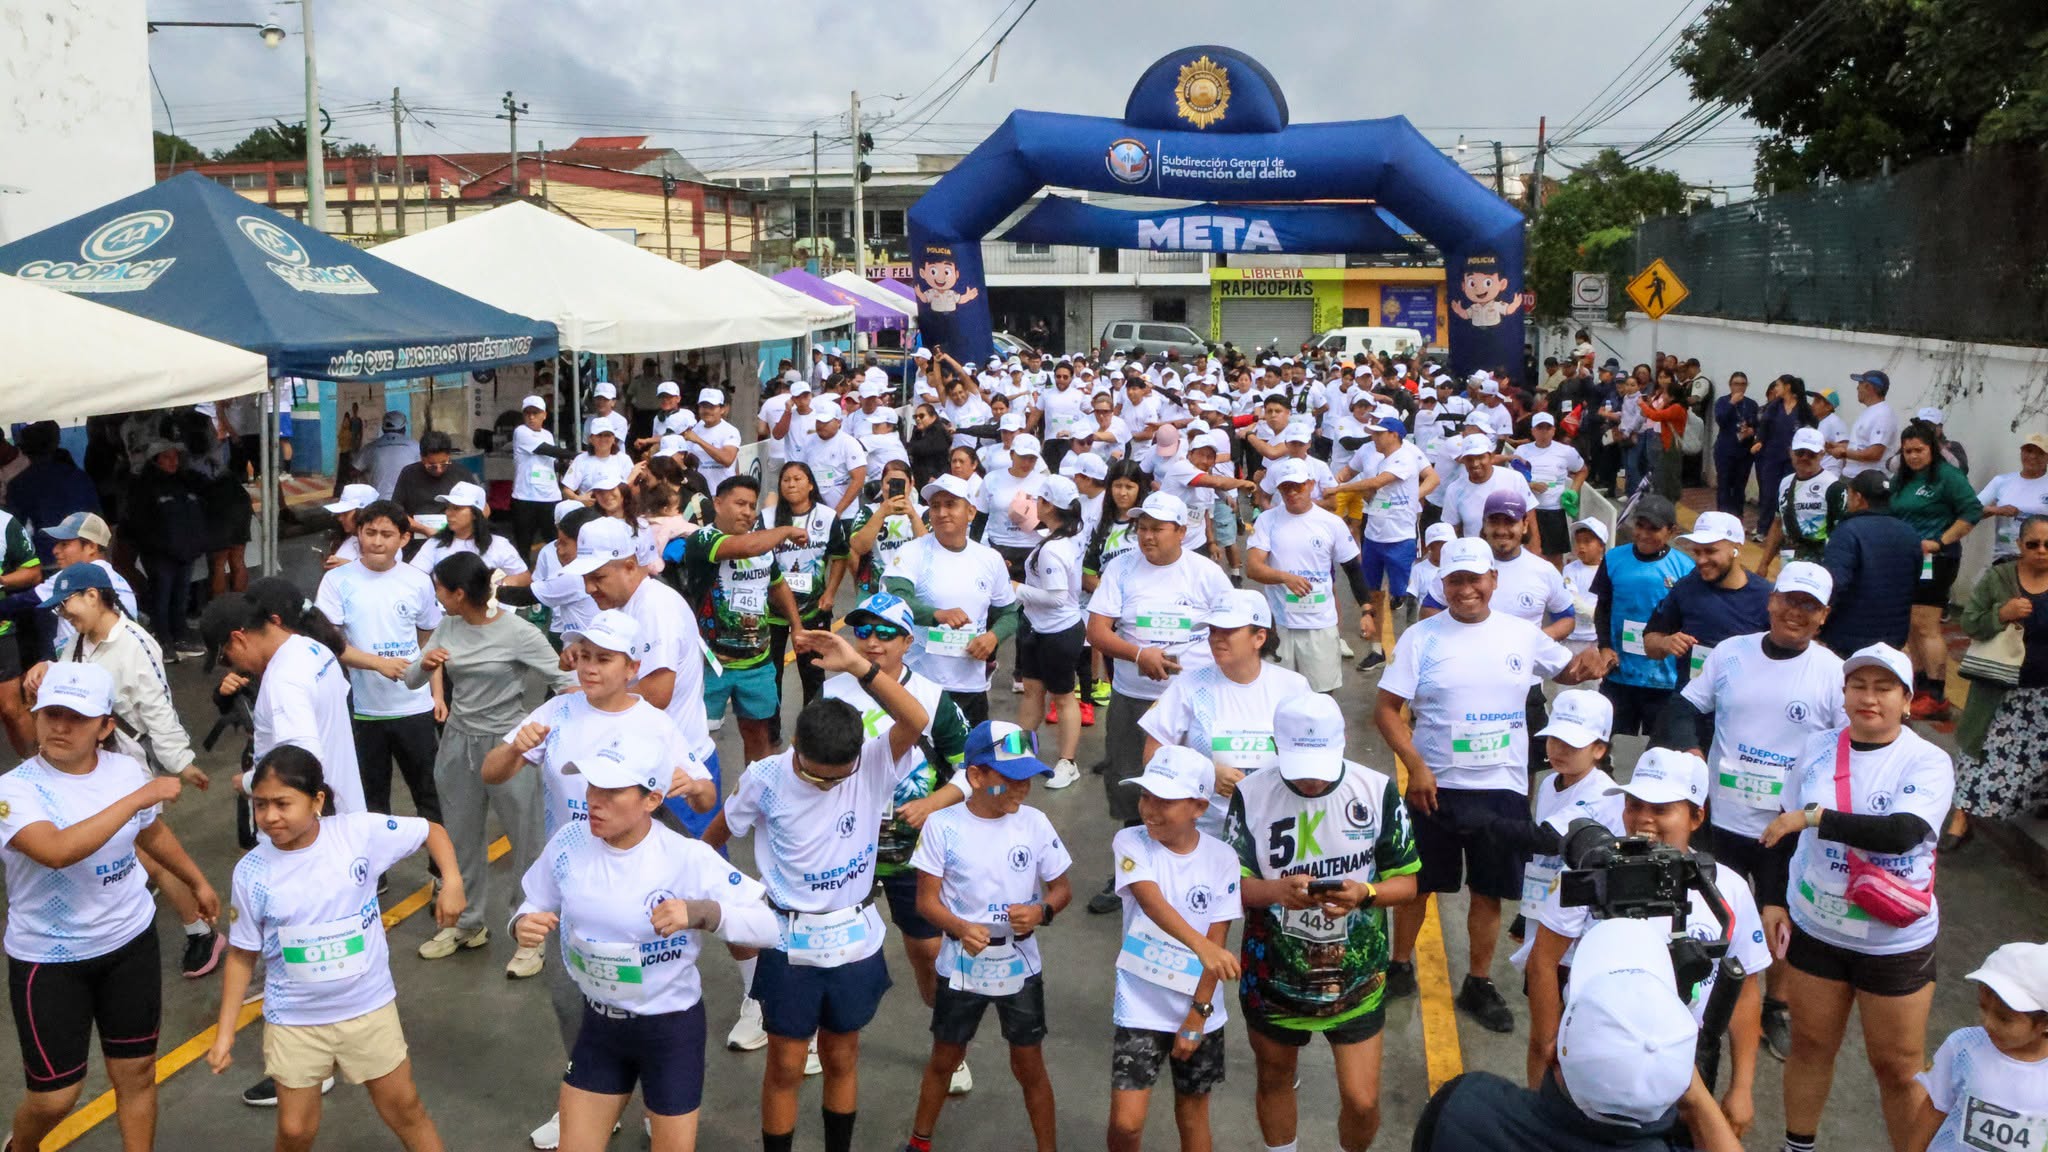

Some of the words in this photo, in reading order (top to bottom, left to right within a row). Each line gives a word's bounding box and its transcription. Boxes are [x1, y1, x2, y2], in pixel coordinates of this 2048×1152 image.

[1162, 155, 1227, 168] Subdirección
[1230, 157, 1269, 168] General
[1271, 157, 1285, 168] de
[1162, 166, 1233, 179] Prevención
[1236, 167, 1256, 179] del
[1259, 166, 1297, 179] delito
[1138, 215, 1284, 252] META
[1467, 256, 1496, 265] POLICIA
[20, 257, 171, 281] COOPACH
[1241, 267, 1305, 279] LIBRERIA
[1221, 280, 1314, 296] RAPICOPIAS
[328, 350, 363, 377] MÁS
[364, 350, 394, 376] QUE
[396, 344, 457, 369] AHORROS
[457, 342, 467, 362] Y
[469, 335, 534, 362] PRÉSTAMOS
[740, 595, 758, 608] 461
[1465, 713, 1478, 721] EL
[1229, 736, 1268, 751] 073
[1738, 743, 1748, 753] EL
[567, 798, 580, 810] EL
[1267, 809, 1327, 870] 5K
[1825, 848, 1840, 860] EL
[95, 864, 110, 876] EL
[803, 872, 819, 883] EL
[987, 903, 1000, 912] EL
[1299, 910, 1336, 932] 448
[670, 934, 688, 947] ES
[806, 929, 851, 949] 026
[303, 942, 349, 963] 018
[970, 960, 1012, 979] 020
[1979, 1118, 2031, 1149] 404
